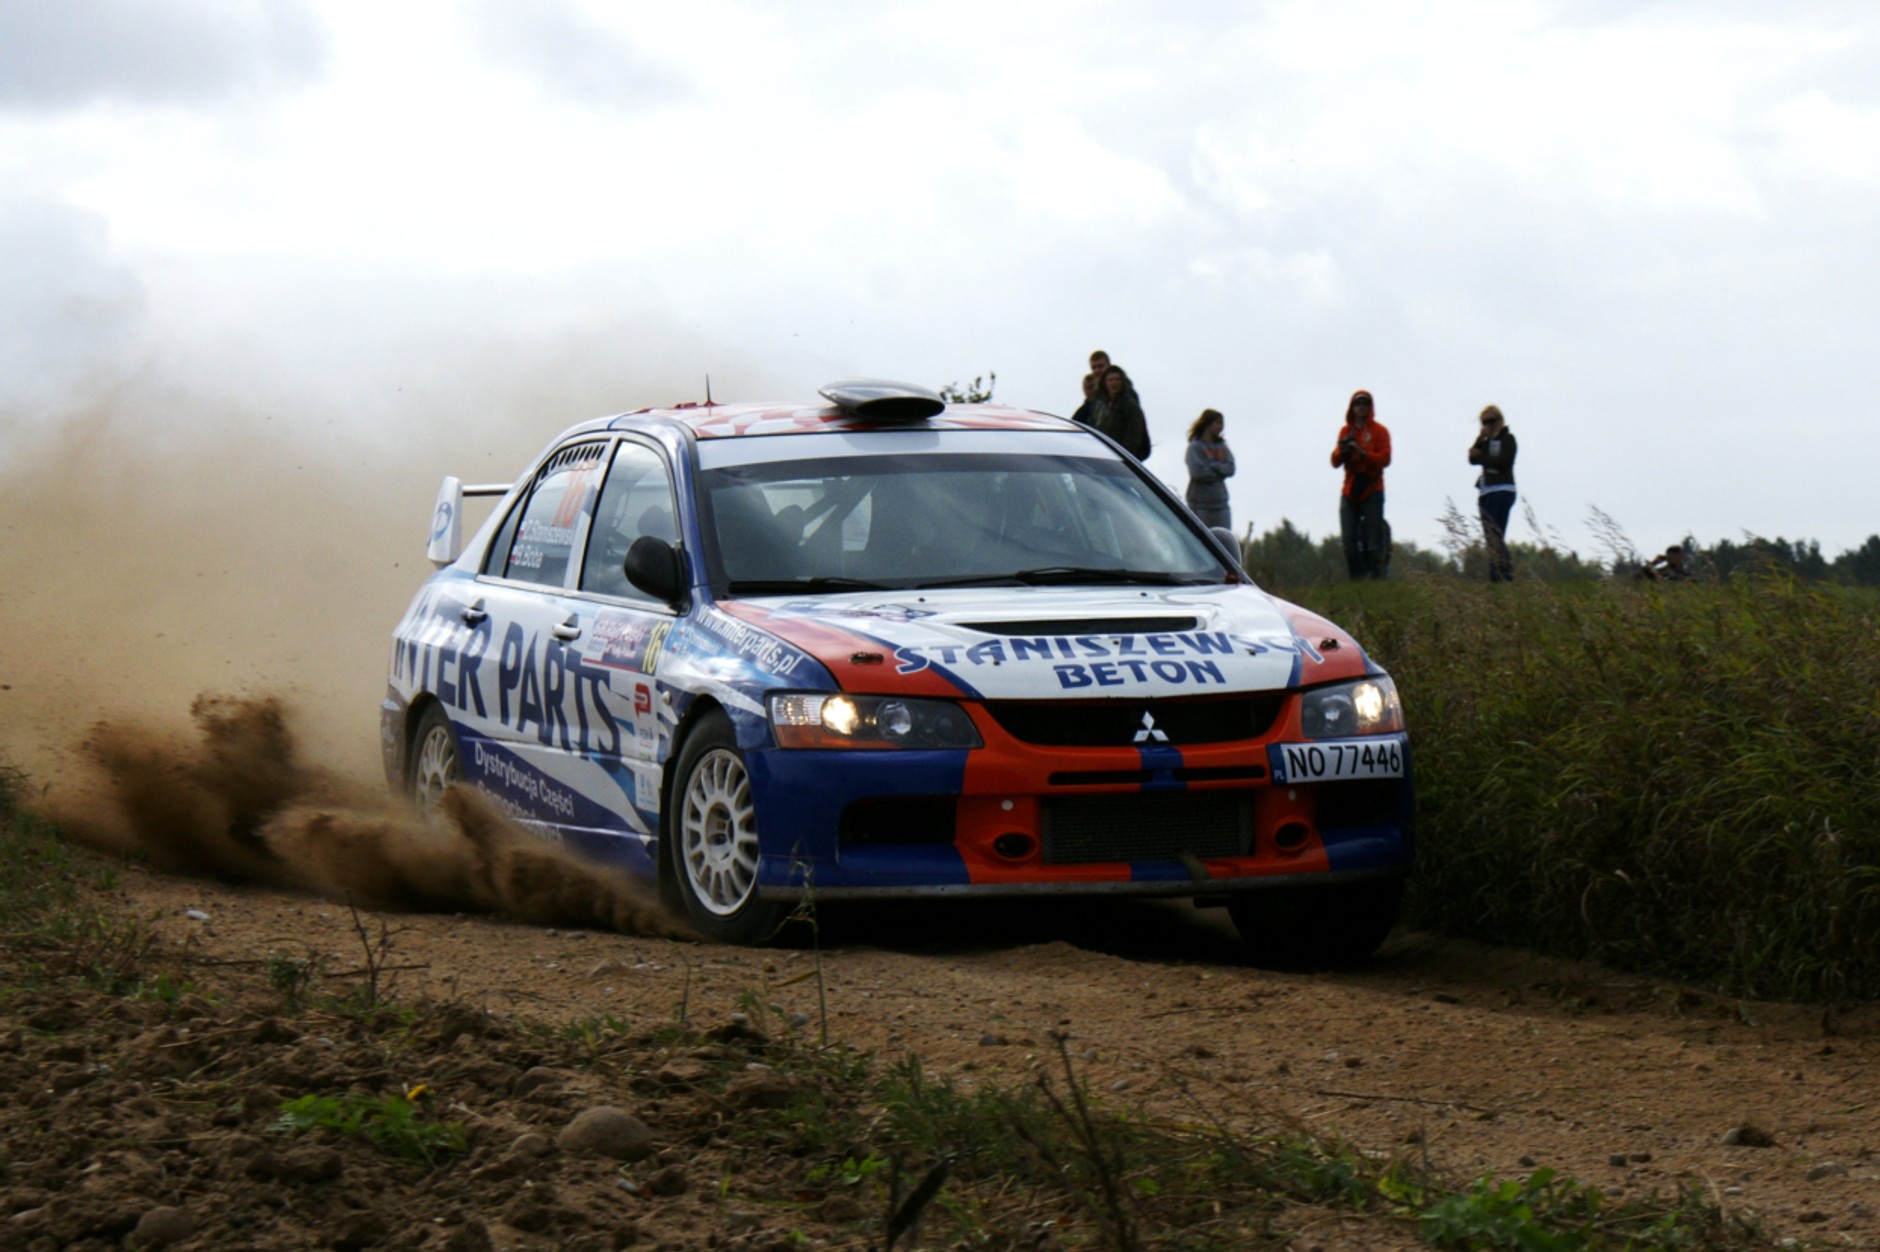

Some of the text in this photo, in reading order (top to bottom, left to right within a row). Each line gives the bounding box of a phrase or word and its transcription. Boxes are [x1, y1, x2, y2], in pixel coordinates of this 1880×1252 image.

[642, 620, 669, 674] 16
[1054, 658, 1226, 689] BETON
[500, 620, 621, 768] PARTS
[475, 741, 575, 817] Dystrybucja Części
[1287, 743, 1400, 779] NO 77446
